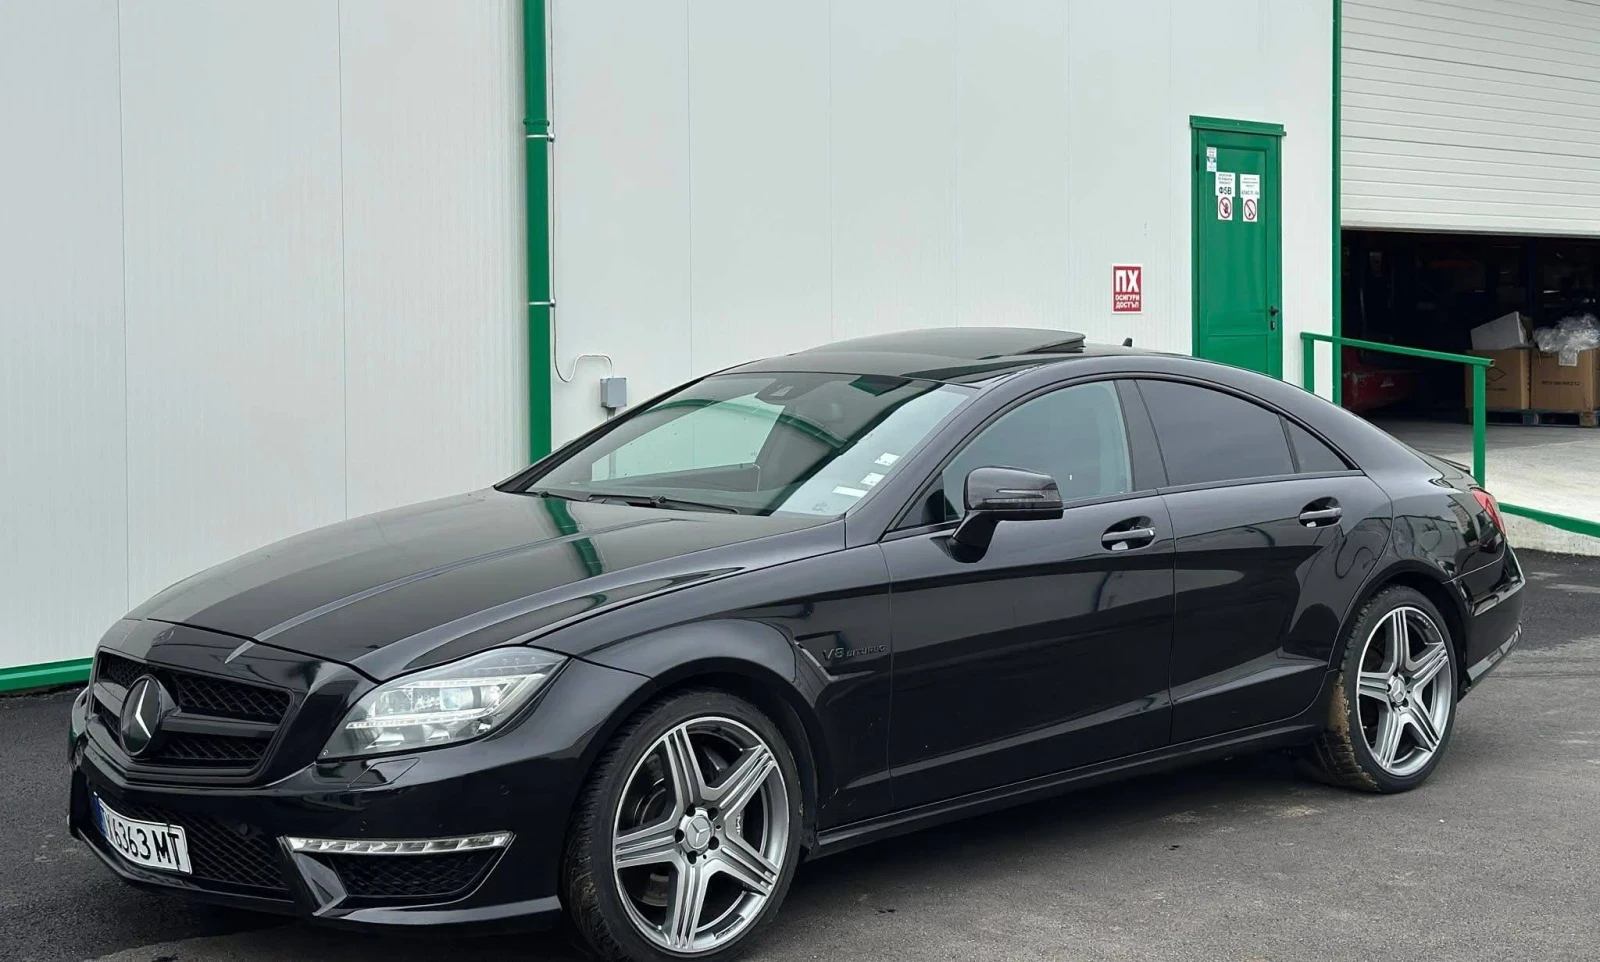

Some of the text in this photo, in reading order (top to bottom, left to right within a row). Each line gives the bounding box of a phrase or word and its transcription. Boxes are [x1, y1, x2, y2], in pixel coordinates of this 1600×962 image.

[1115, 269, 1140, 292] ПХ
[1115, 301, 1140, 309] ДОСТЪП
[822, 647, 845, 661] V8
[151, 830, 180, 866] MT
